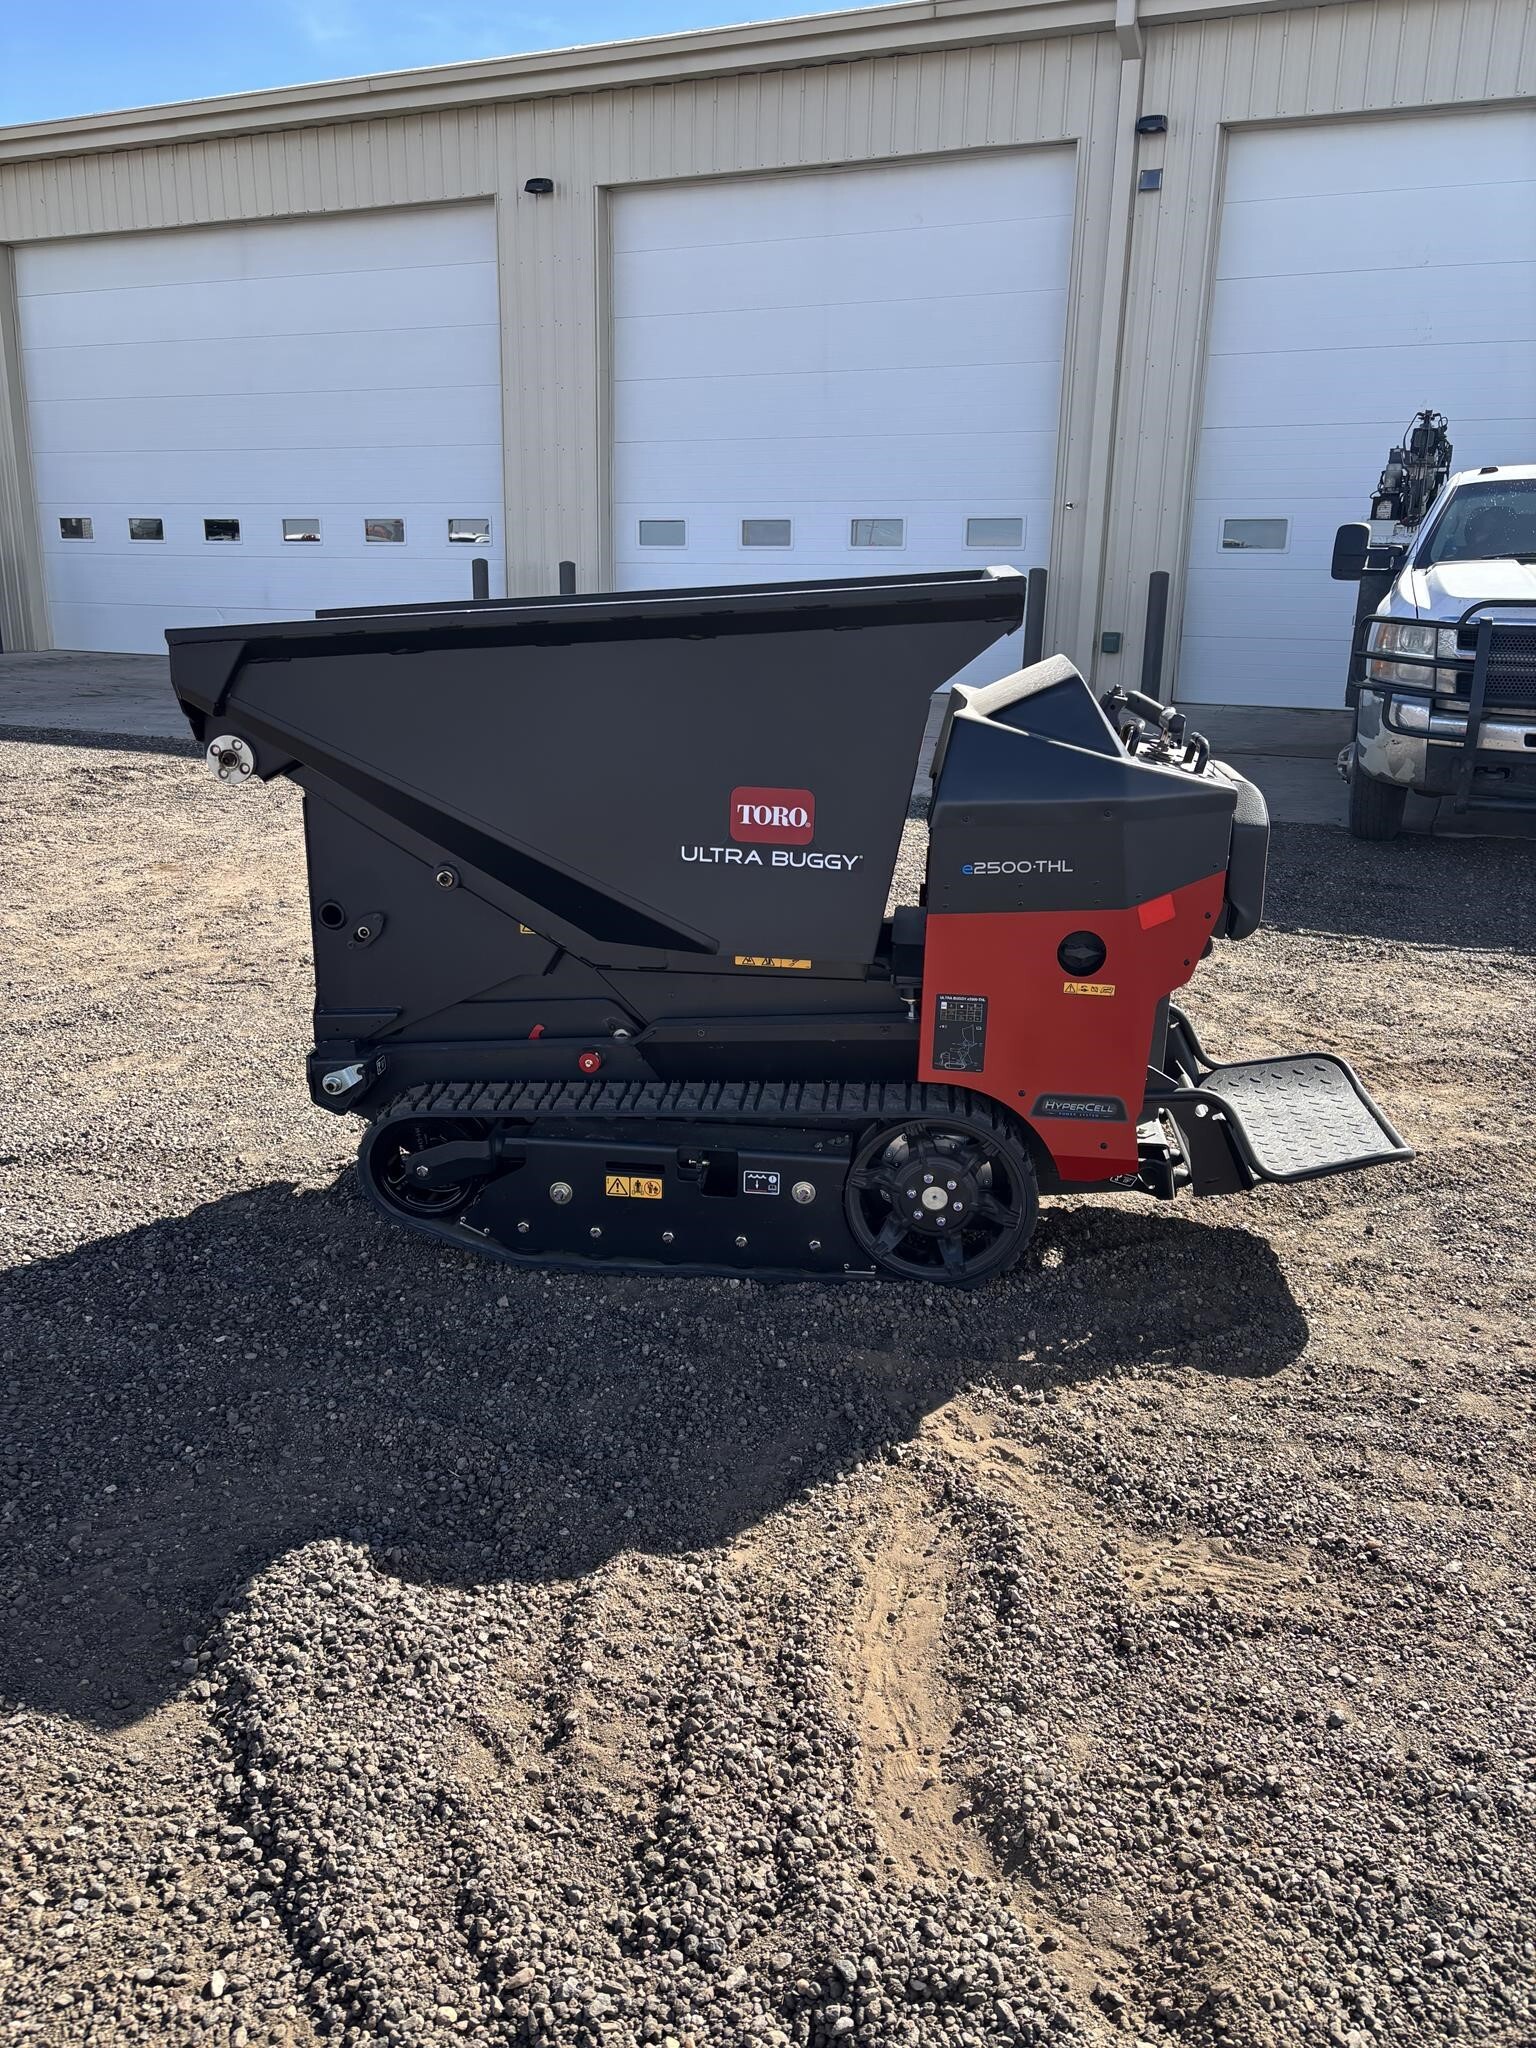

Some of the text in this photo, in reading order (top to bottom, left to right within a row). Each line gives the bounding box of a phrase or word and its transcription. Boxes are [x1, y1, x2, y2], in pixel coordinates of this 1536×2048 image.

[737, 804, 809, 828] TORO
[681, 845, 860, 871] ULTRA BUGGY
